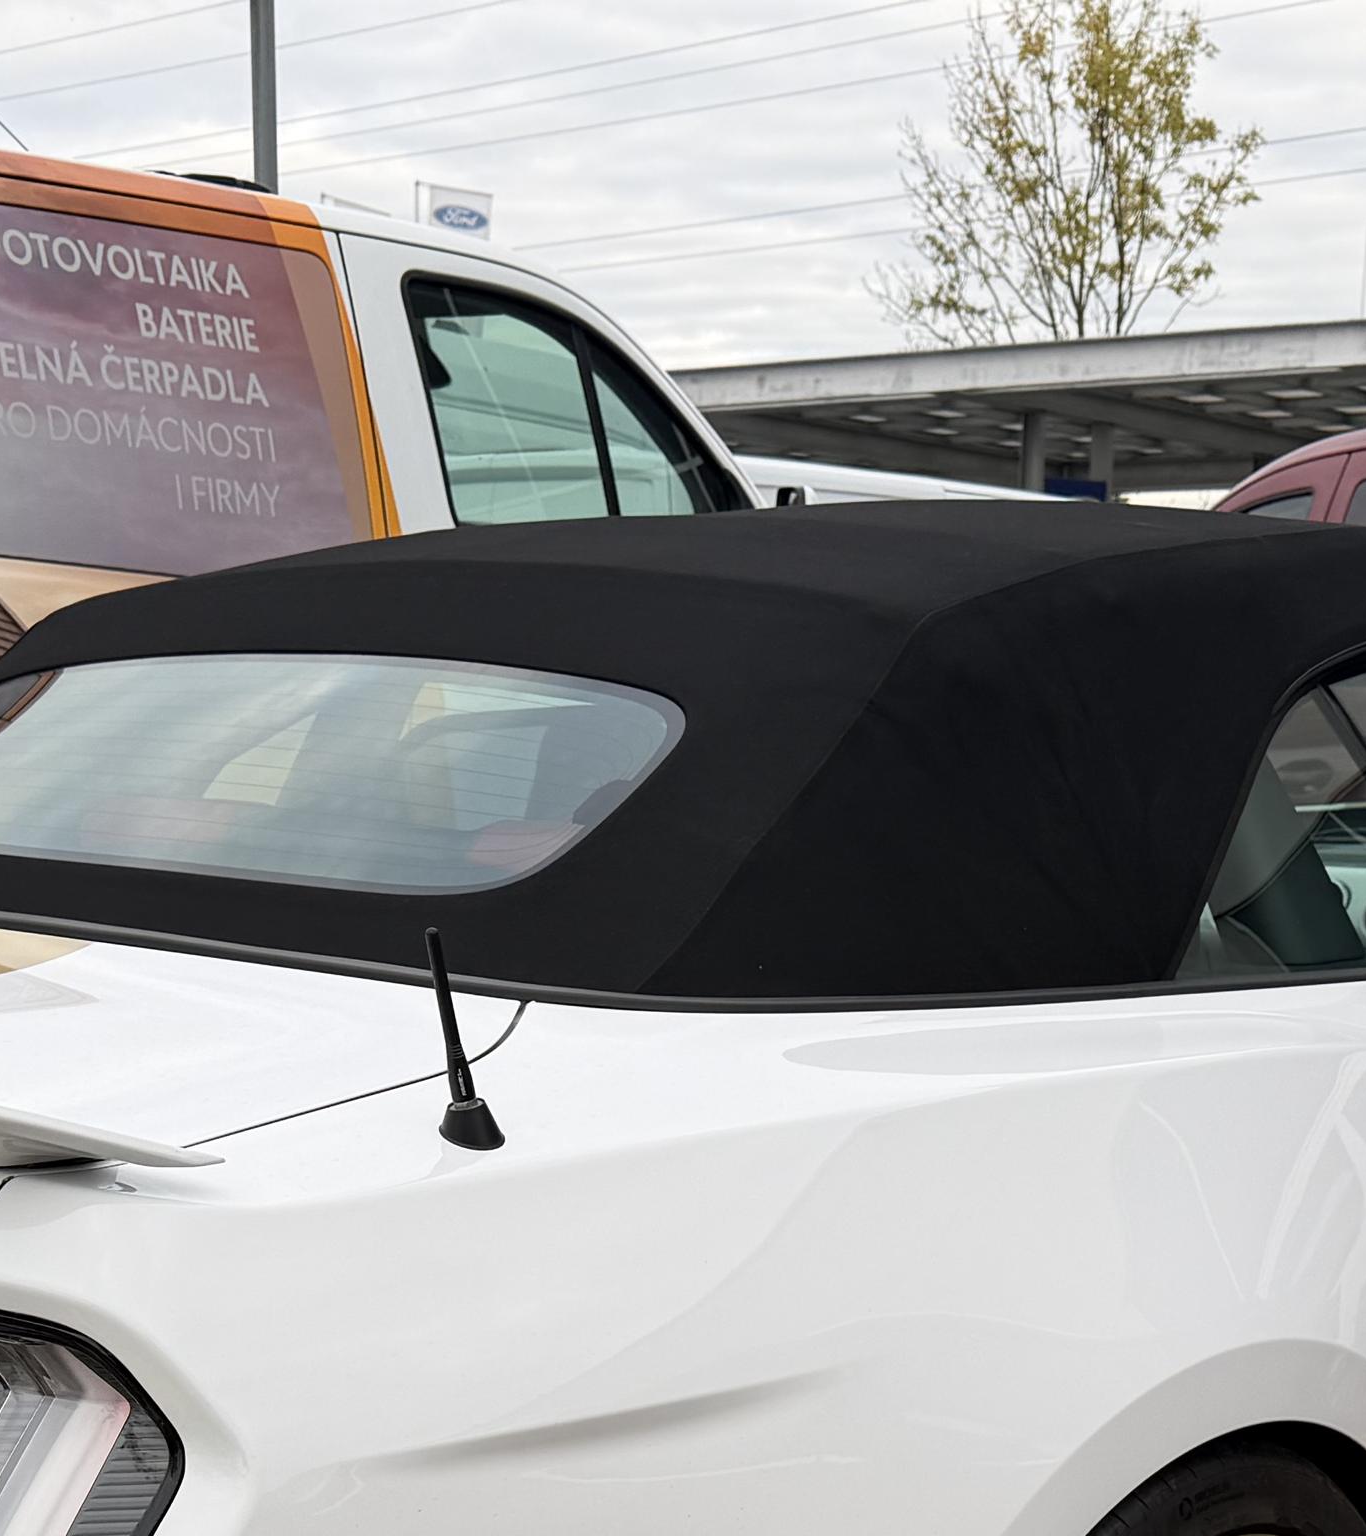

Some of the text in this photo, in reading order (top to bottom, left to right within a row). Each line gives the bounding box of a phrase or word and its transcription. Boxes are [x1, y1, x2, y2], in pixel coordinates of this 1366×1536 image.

[135, 302, 260, 354] BATERIE
[100, 345, 270, 409] ČERPADLA
[47, 405, 277, 464] DOMÁCNOSTI
[175, 474, 280, 519] I FIRMY
